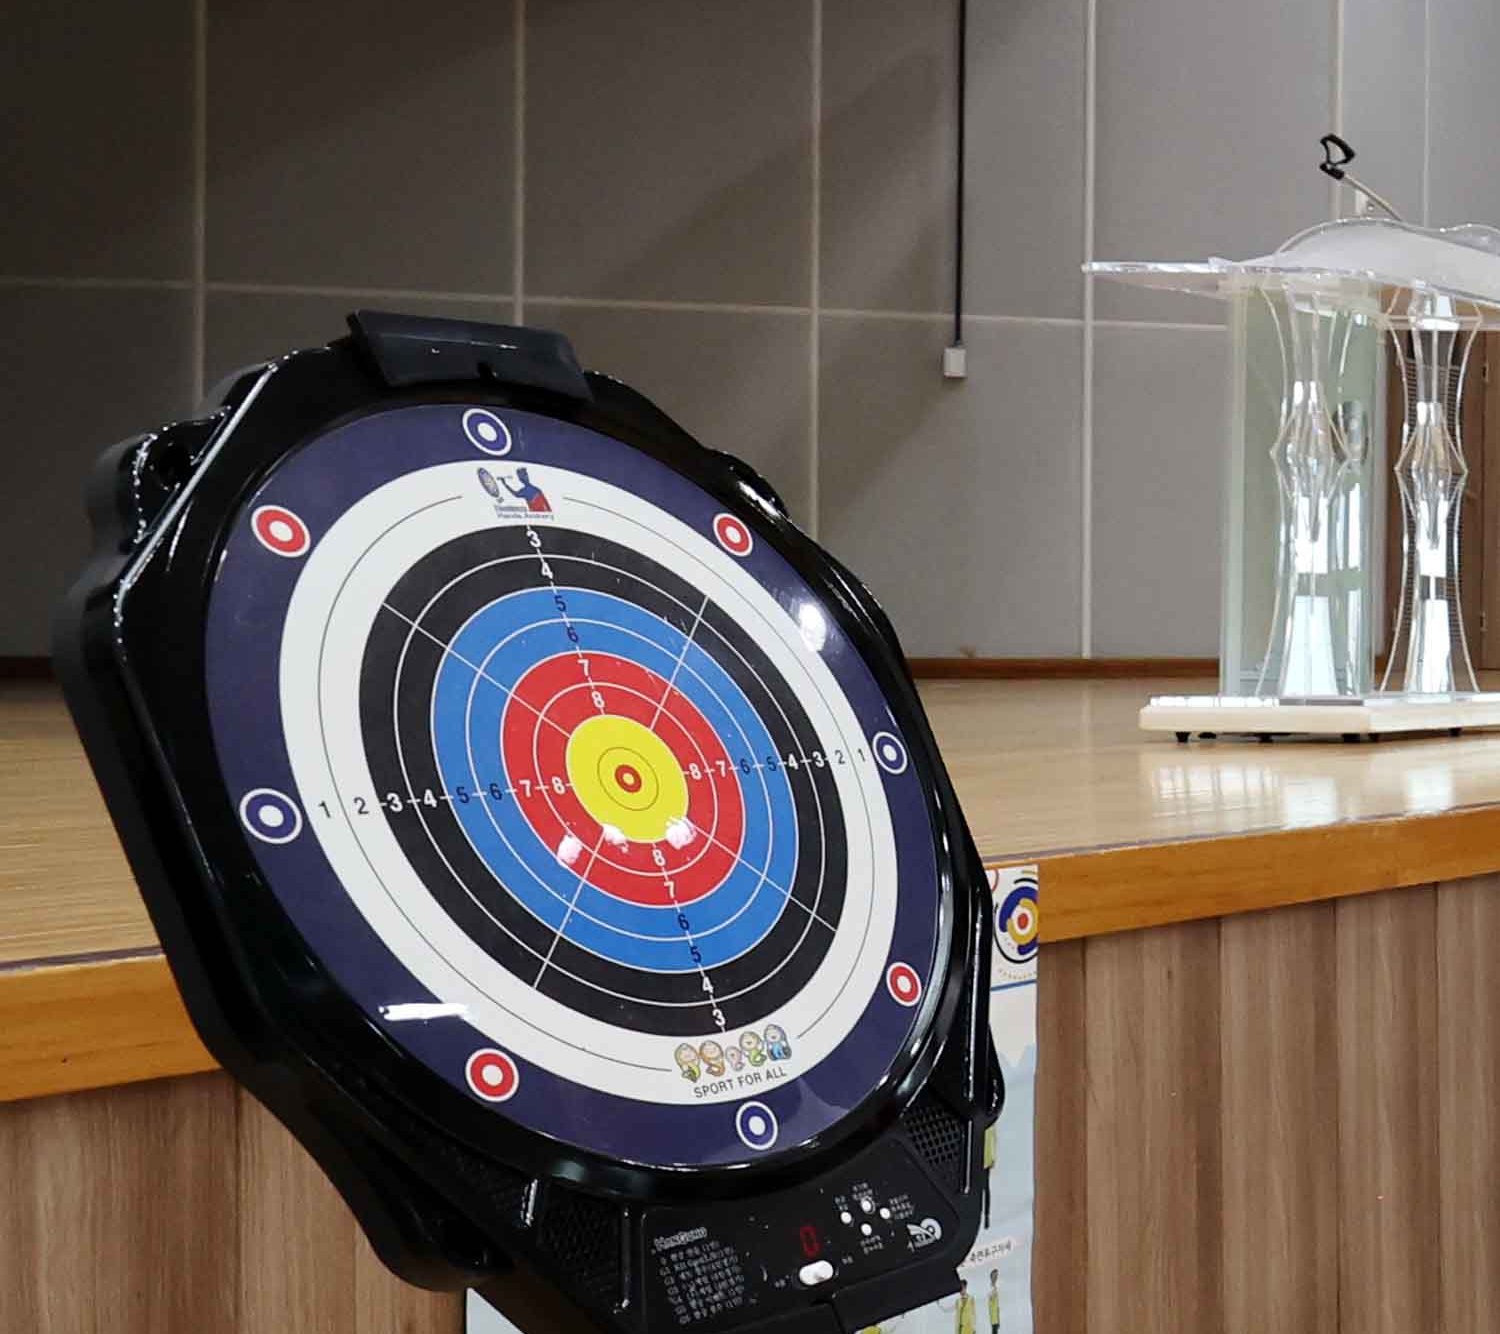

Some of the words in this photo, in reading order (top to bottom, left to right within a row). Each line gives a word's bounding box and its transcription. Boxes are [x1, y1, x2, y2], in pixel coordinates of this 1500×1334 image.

[527, 530, 541, 548] 3
[541, 563, 553, 579] 4
[554, 595, 567, 612] 5
[567, 626, 579, 643] 6
[578, 658, 589, 677] 7
[592, 690, 605, 708] 8
[688, 762, 702, 780] 8
[715, 760, 729, 778] 7
[739, 758, 751, 776] 6
[766, 755, 778, 772] 5
[787, 752, 800, 770] 4
[812, 750, 826, 768] 3
[834, 749, 846, 765] 2
[857, 747, 867, 763] 1
[318, 800, 332, 818] 1
[354, 796, 369, 815] 2
[386, 792, 403, 812] 3
[423, 789, 438, 808] 4
[455, 786, 470, 804] 5
[489, 782, 503, 801] 6
[518, 779, 533, 798] 7
[551, 776, 566, 795] 8
[652, 849, 665, 866] 8
[663, 880, 675, 899] 7
[677, 913, 690, 930] 6
[690, 945, 702, 964] 5
[702, 976, 714, 994] 4
[712, 1008, 726, 1027] 3
[693, 1076, 734, 1099] SPORT
[736, 1071, 763, 1089] FOR
[766, 1065, 787, 1081] ALL
